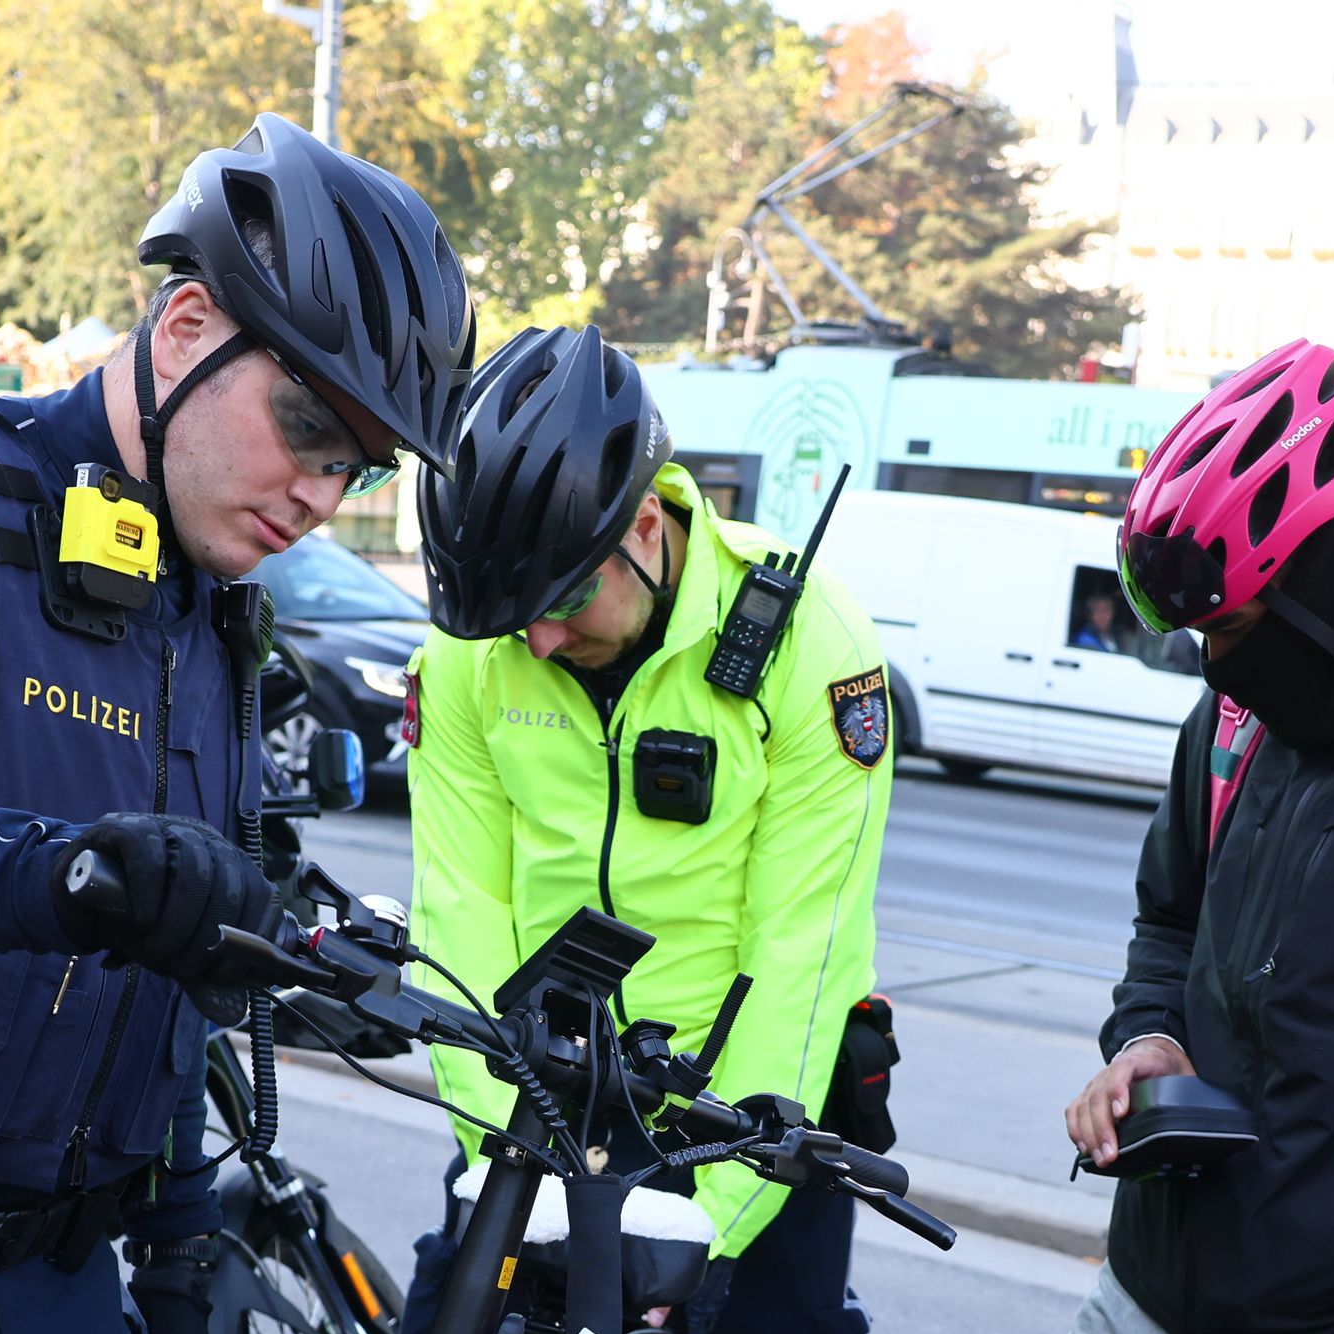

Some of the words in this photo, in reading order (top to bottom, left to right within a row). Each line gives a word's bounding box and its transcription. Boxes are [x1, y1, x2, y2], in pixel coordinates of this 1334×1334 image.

[1047, 405, 1090, 446] all
[1101, 409, 1112, 446] i
[1280, 416, 1323, 450] foodora
[78, 469, 88, 488] 793
[23, 677, 141, 740] POLIZEI
